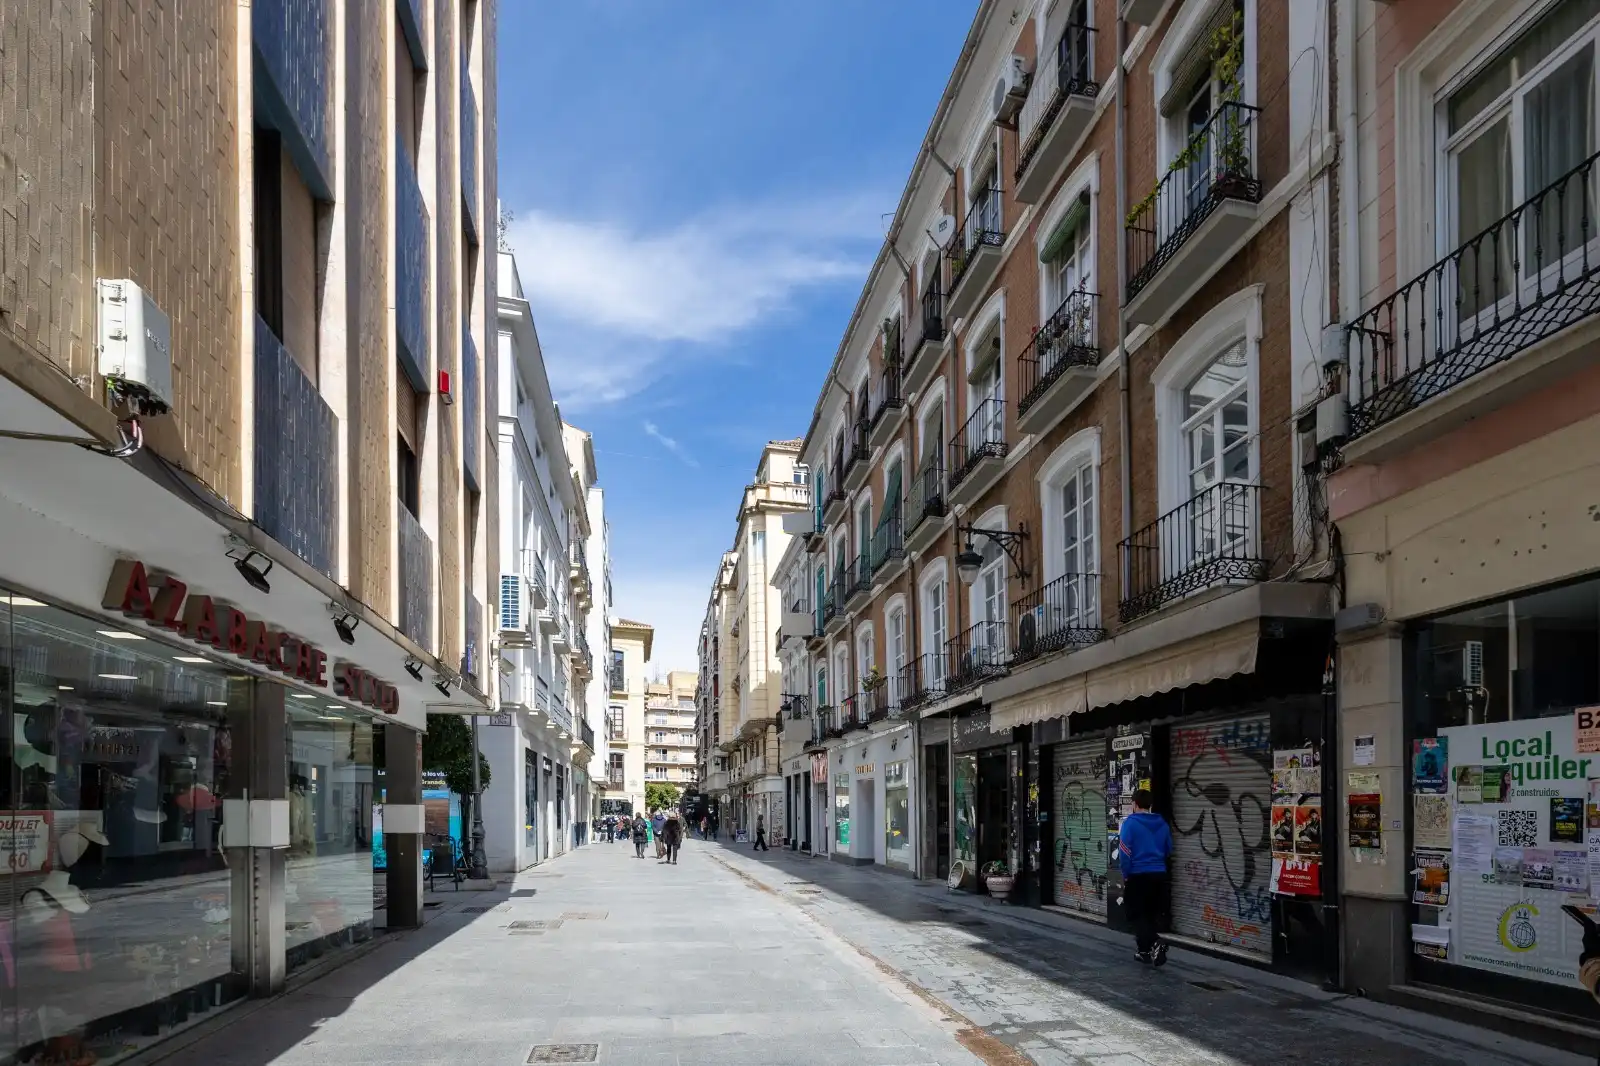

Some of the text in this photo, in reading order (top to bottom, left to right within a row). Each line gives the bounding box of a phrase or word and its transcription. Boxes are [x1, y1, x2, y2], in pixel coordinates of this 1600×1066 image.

[105, 560, 328, 687] AZABACHE
[1482, 731, 1552, 759] Local
[1501, 755, 1592, 786] quiler
[1516, 787, 1560, 797] construidos
[1463, 953, 1576, 980] www.coronaintermundo.com
